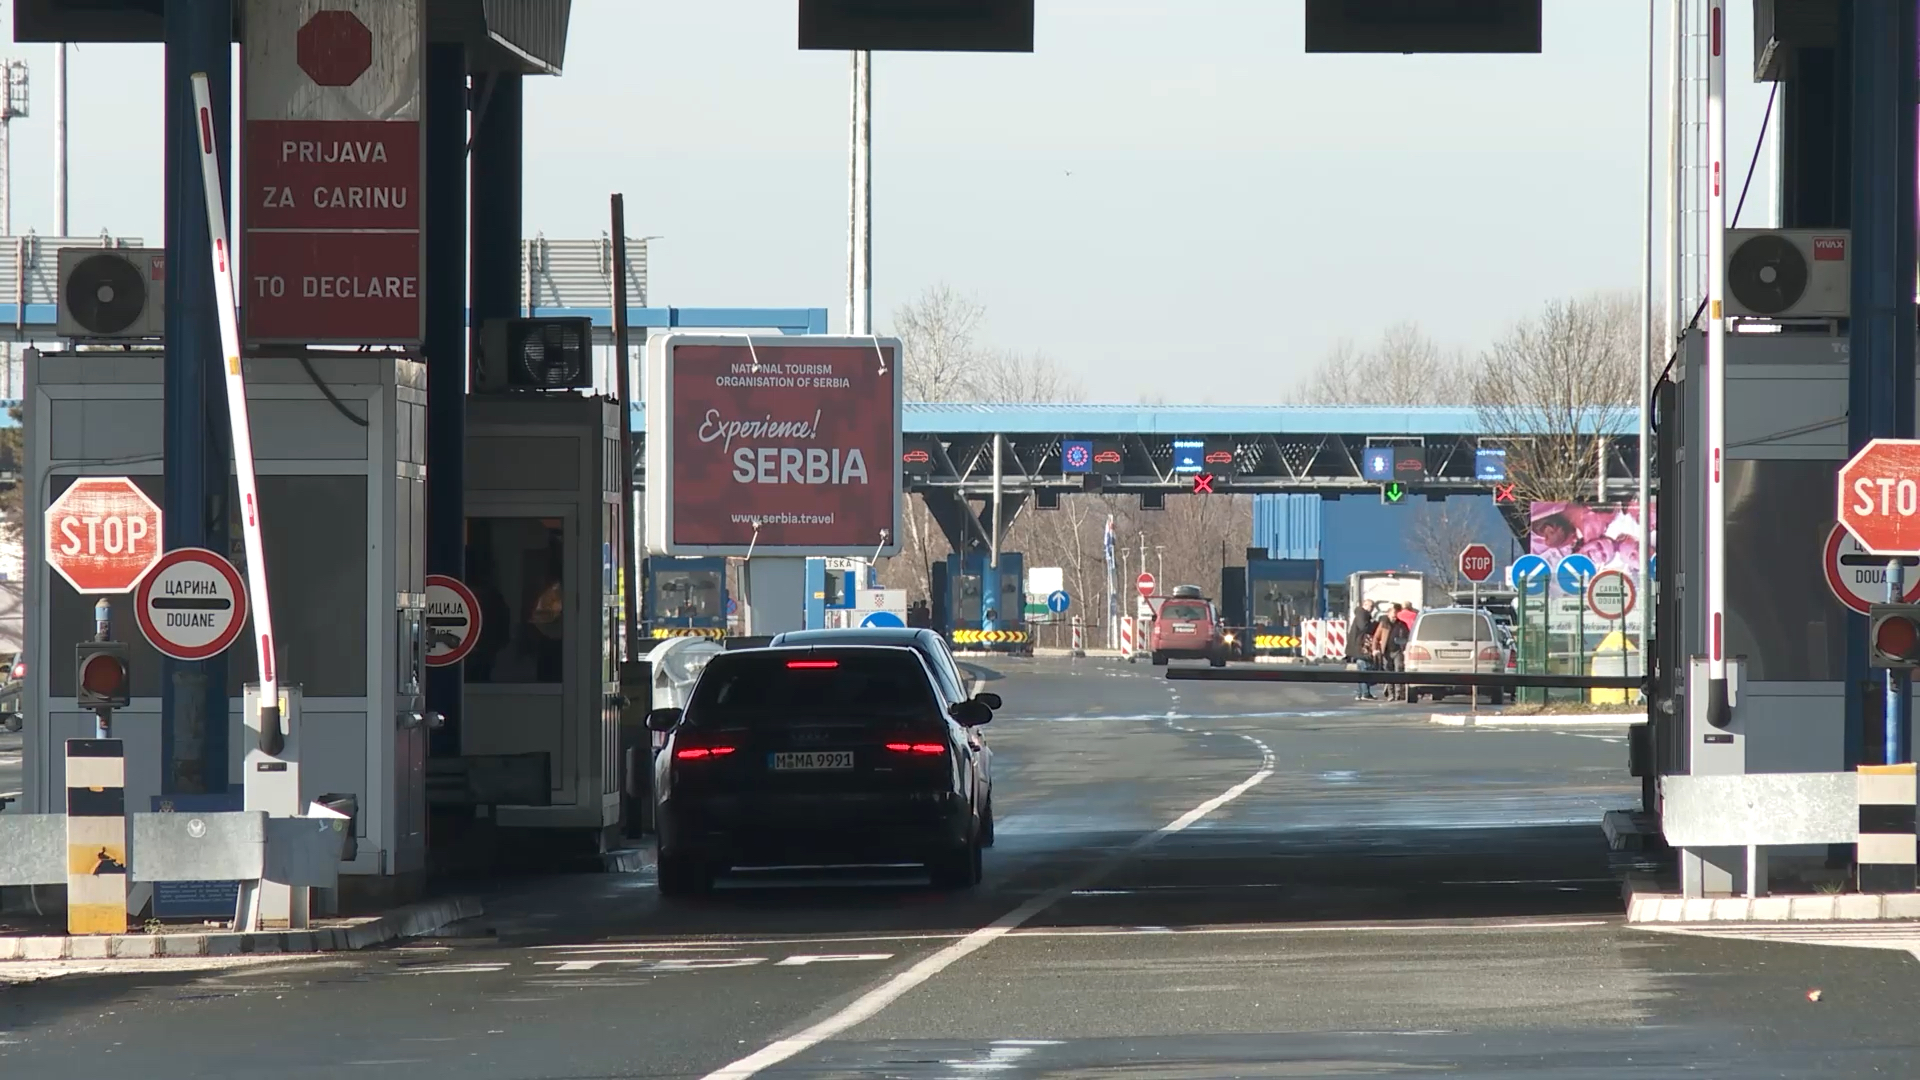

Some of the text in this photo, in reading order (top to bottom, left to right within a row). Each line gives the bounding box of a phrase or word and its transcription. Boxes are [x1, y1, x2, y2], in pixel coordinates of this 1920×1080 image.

[282, 141, 388, 163] PRIJAVA
[263, 186, 407, 208] ZA CARINU
[1815, 240, 1844, 249] VIVAX
[254, 276, 417, 298] TO DECLARE
[731, 363, 832, 375] NATONAL TOURISM
[716, 376, 850, 388] ORGANISATION OF SERBIA
[699, 408, 821, 454] Experience!
[732, 447, 868, 485] SERBIA
[1854, 477, 1916, 516] STO
[731, 512, 834, 524] www.serbia.travel
[60, 516, 148, 556] STOP
[825, 559, 852, 568] TSKA
[1464, 557, 1491, 571] STOP
[1855, 569, 1887, 584] DOUA
[165, 580, 218, 598] ЦАРИНА
[1599, 585, 1620, 593] CARIN
[1597, 597, 1621, 605] DOUAN
[426, 602, 464, 616] ИЦИЈА
[166, 612, 216, 629] DOUANE
[817, 753, 853, 767] 9991
